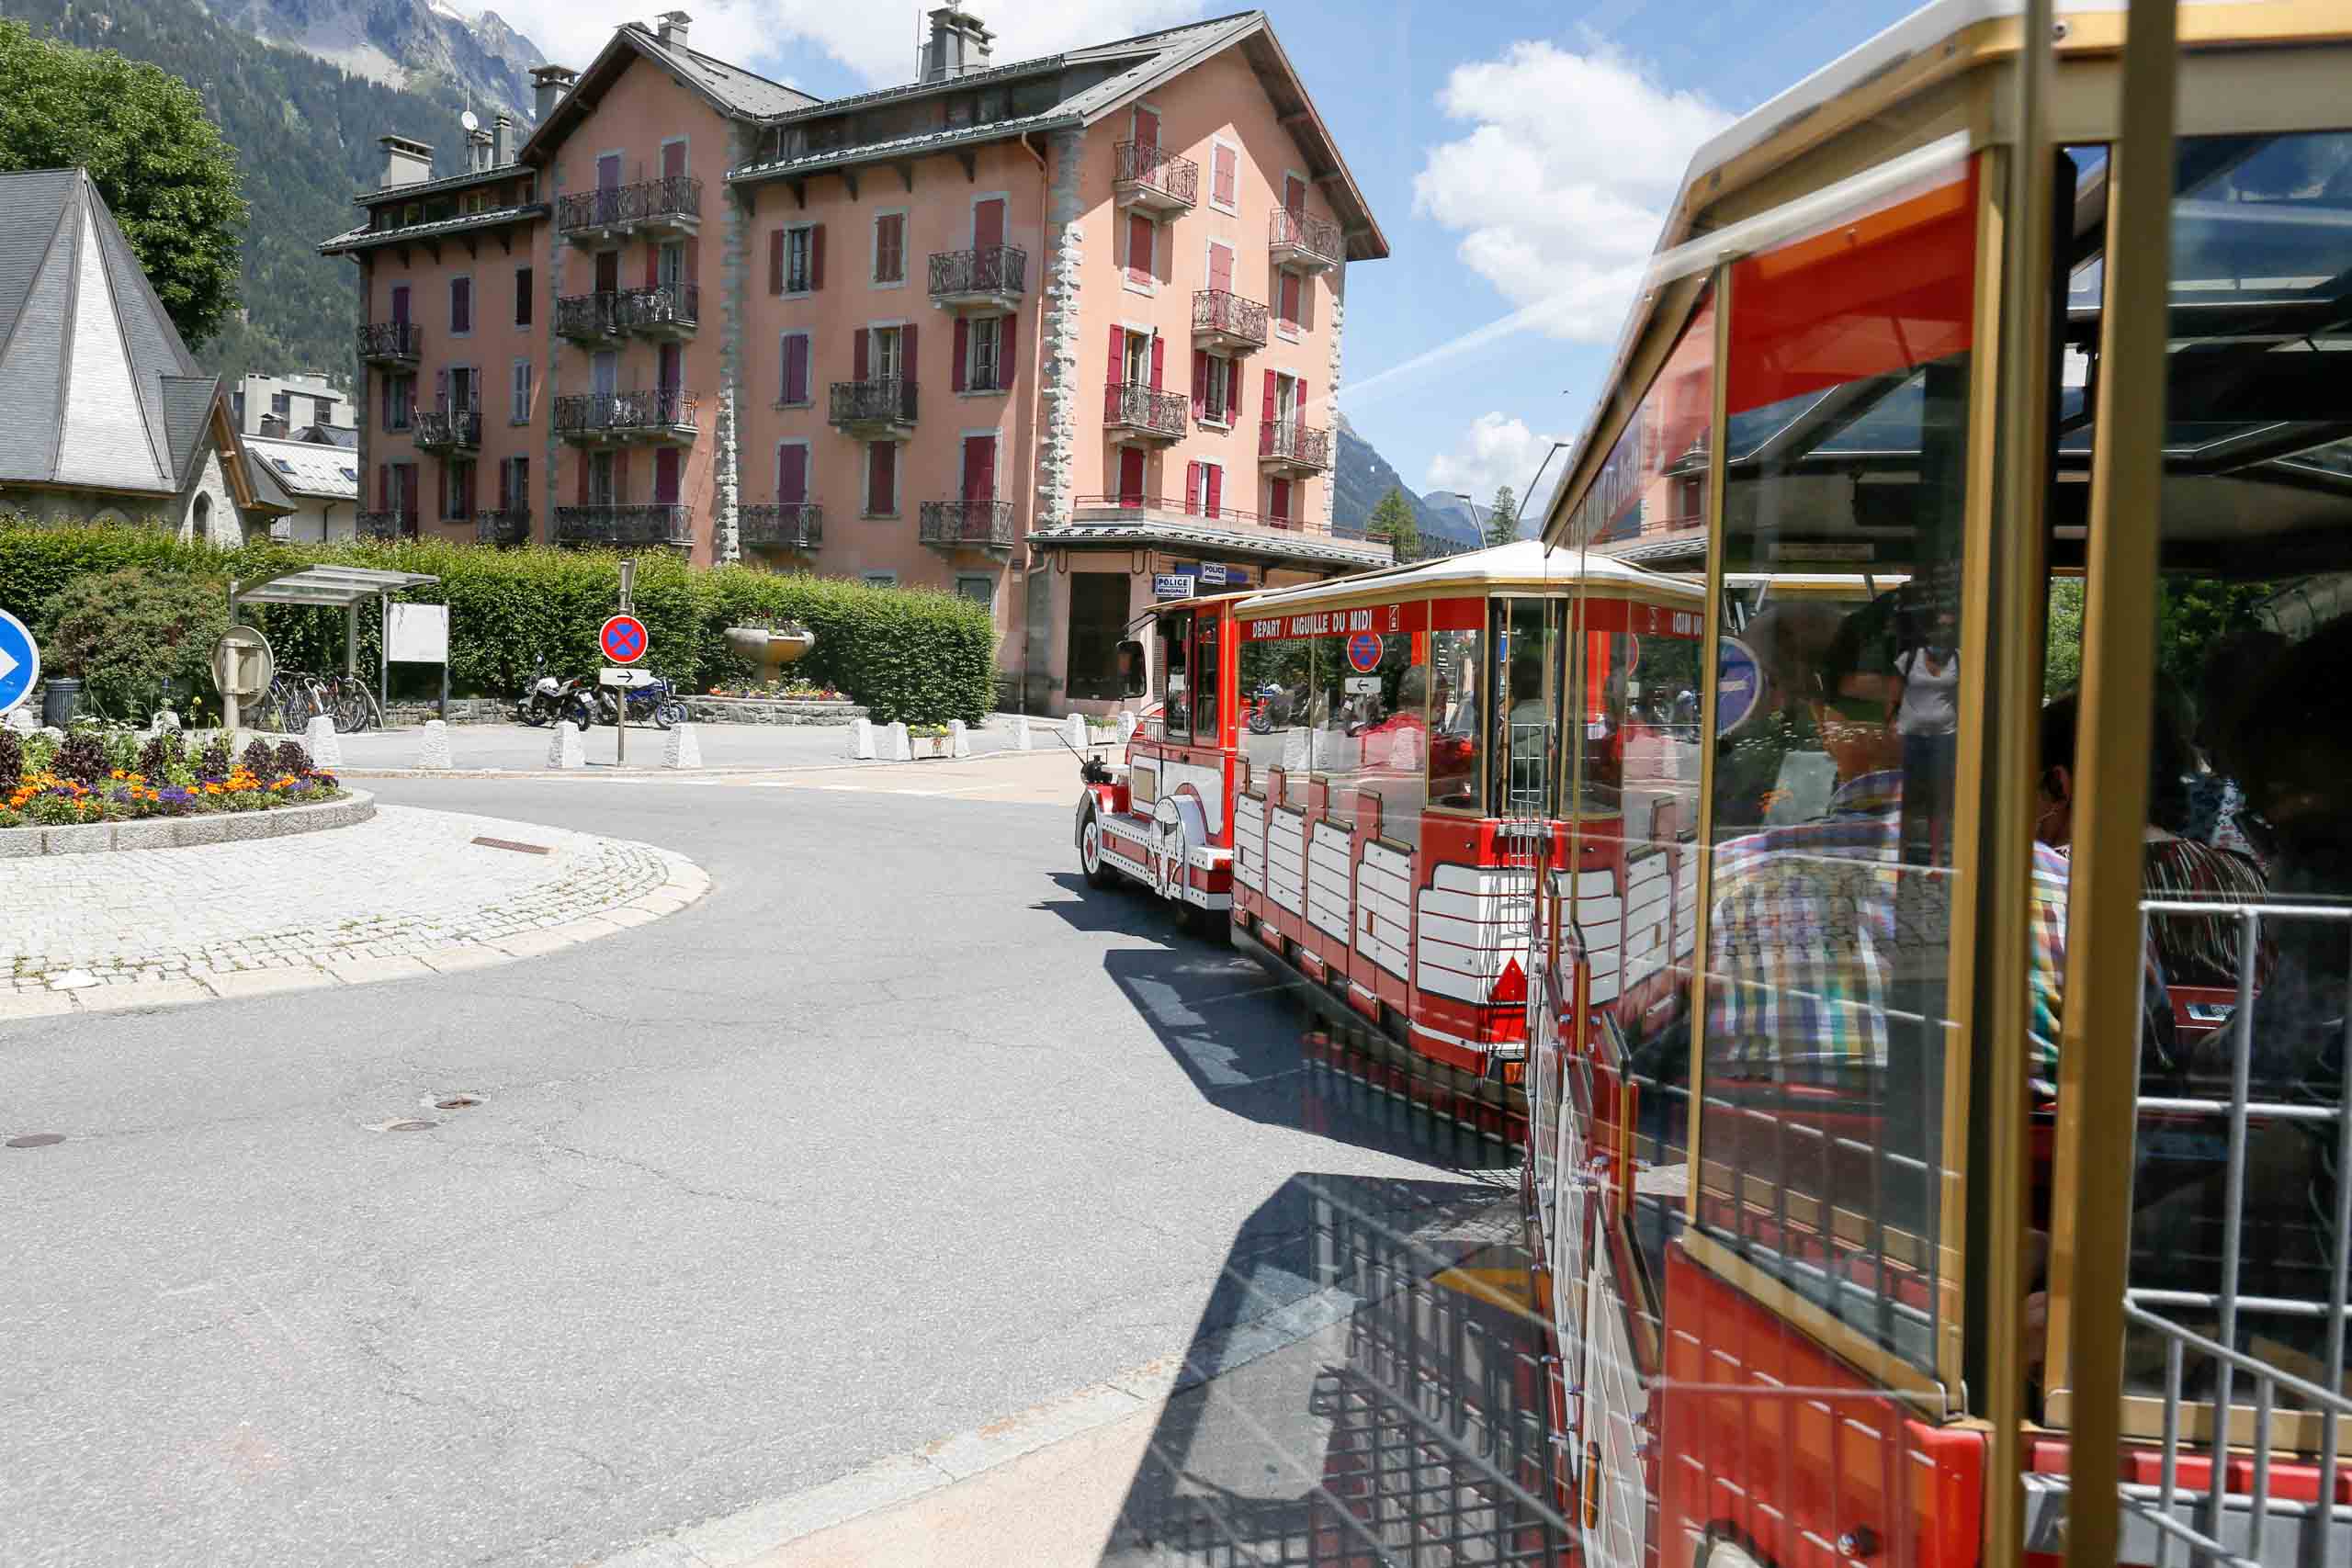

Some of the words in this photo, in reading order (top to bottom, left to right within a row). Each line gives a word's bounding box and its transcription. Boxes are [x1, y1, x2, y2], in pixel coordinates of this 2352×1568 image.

[1204, 565, 1225, 574] POLICE
[1158, 578, 1188, 586] POLICE
[1291, 614, 1329, 636] AIGUILLE
[1332, 612, 1346, 633] DU
[1350, 609, 1373, 632] MIDI
